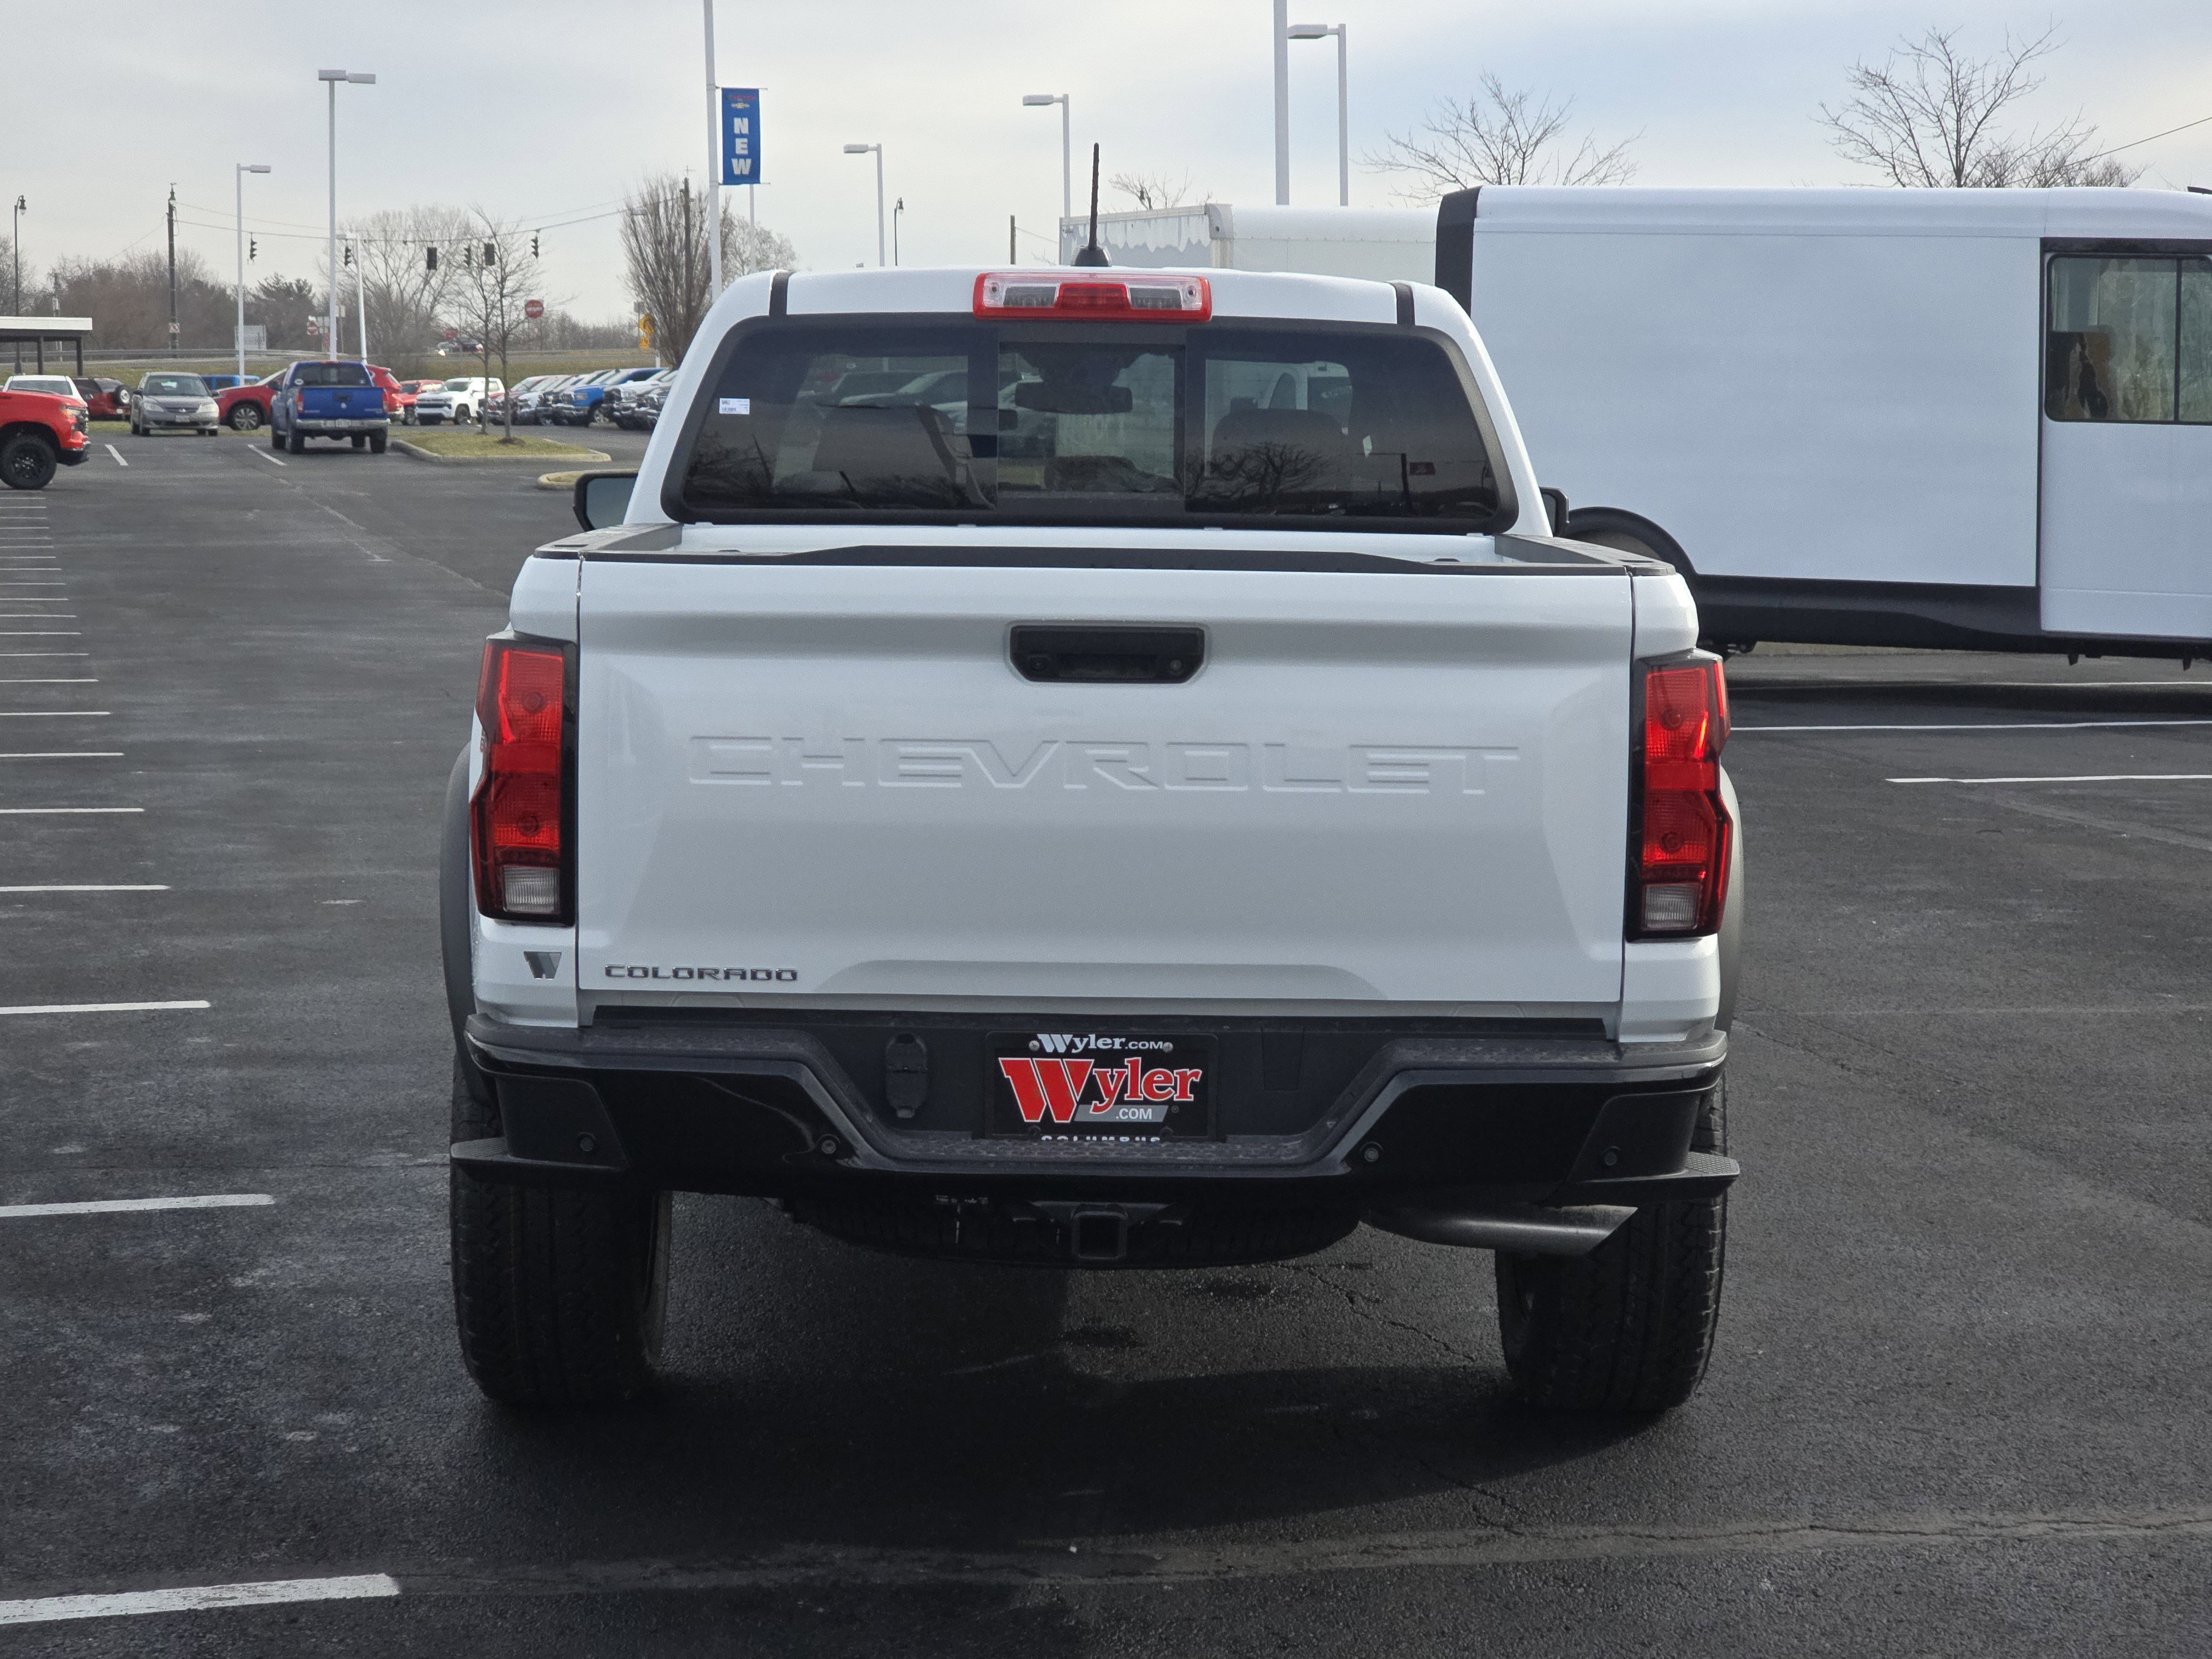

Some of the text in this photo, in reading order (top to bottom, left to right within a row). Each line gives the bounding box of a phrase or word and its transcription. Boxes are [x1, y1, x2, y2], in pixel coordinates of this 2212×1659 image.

[731, 117, 752, 175] NEW
[689, 735, 1520, 795] CHEVROLET
[605, 964, 798, 981] COLORADO
[998, 1057, 1202, 1123] Wyler
